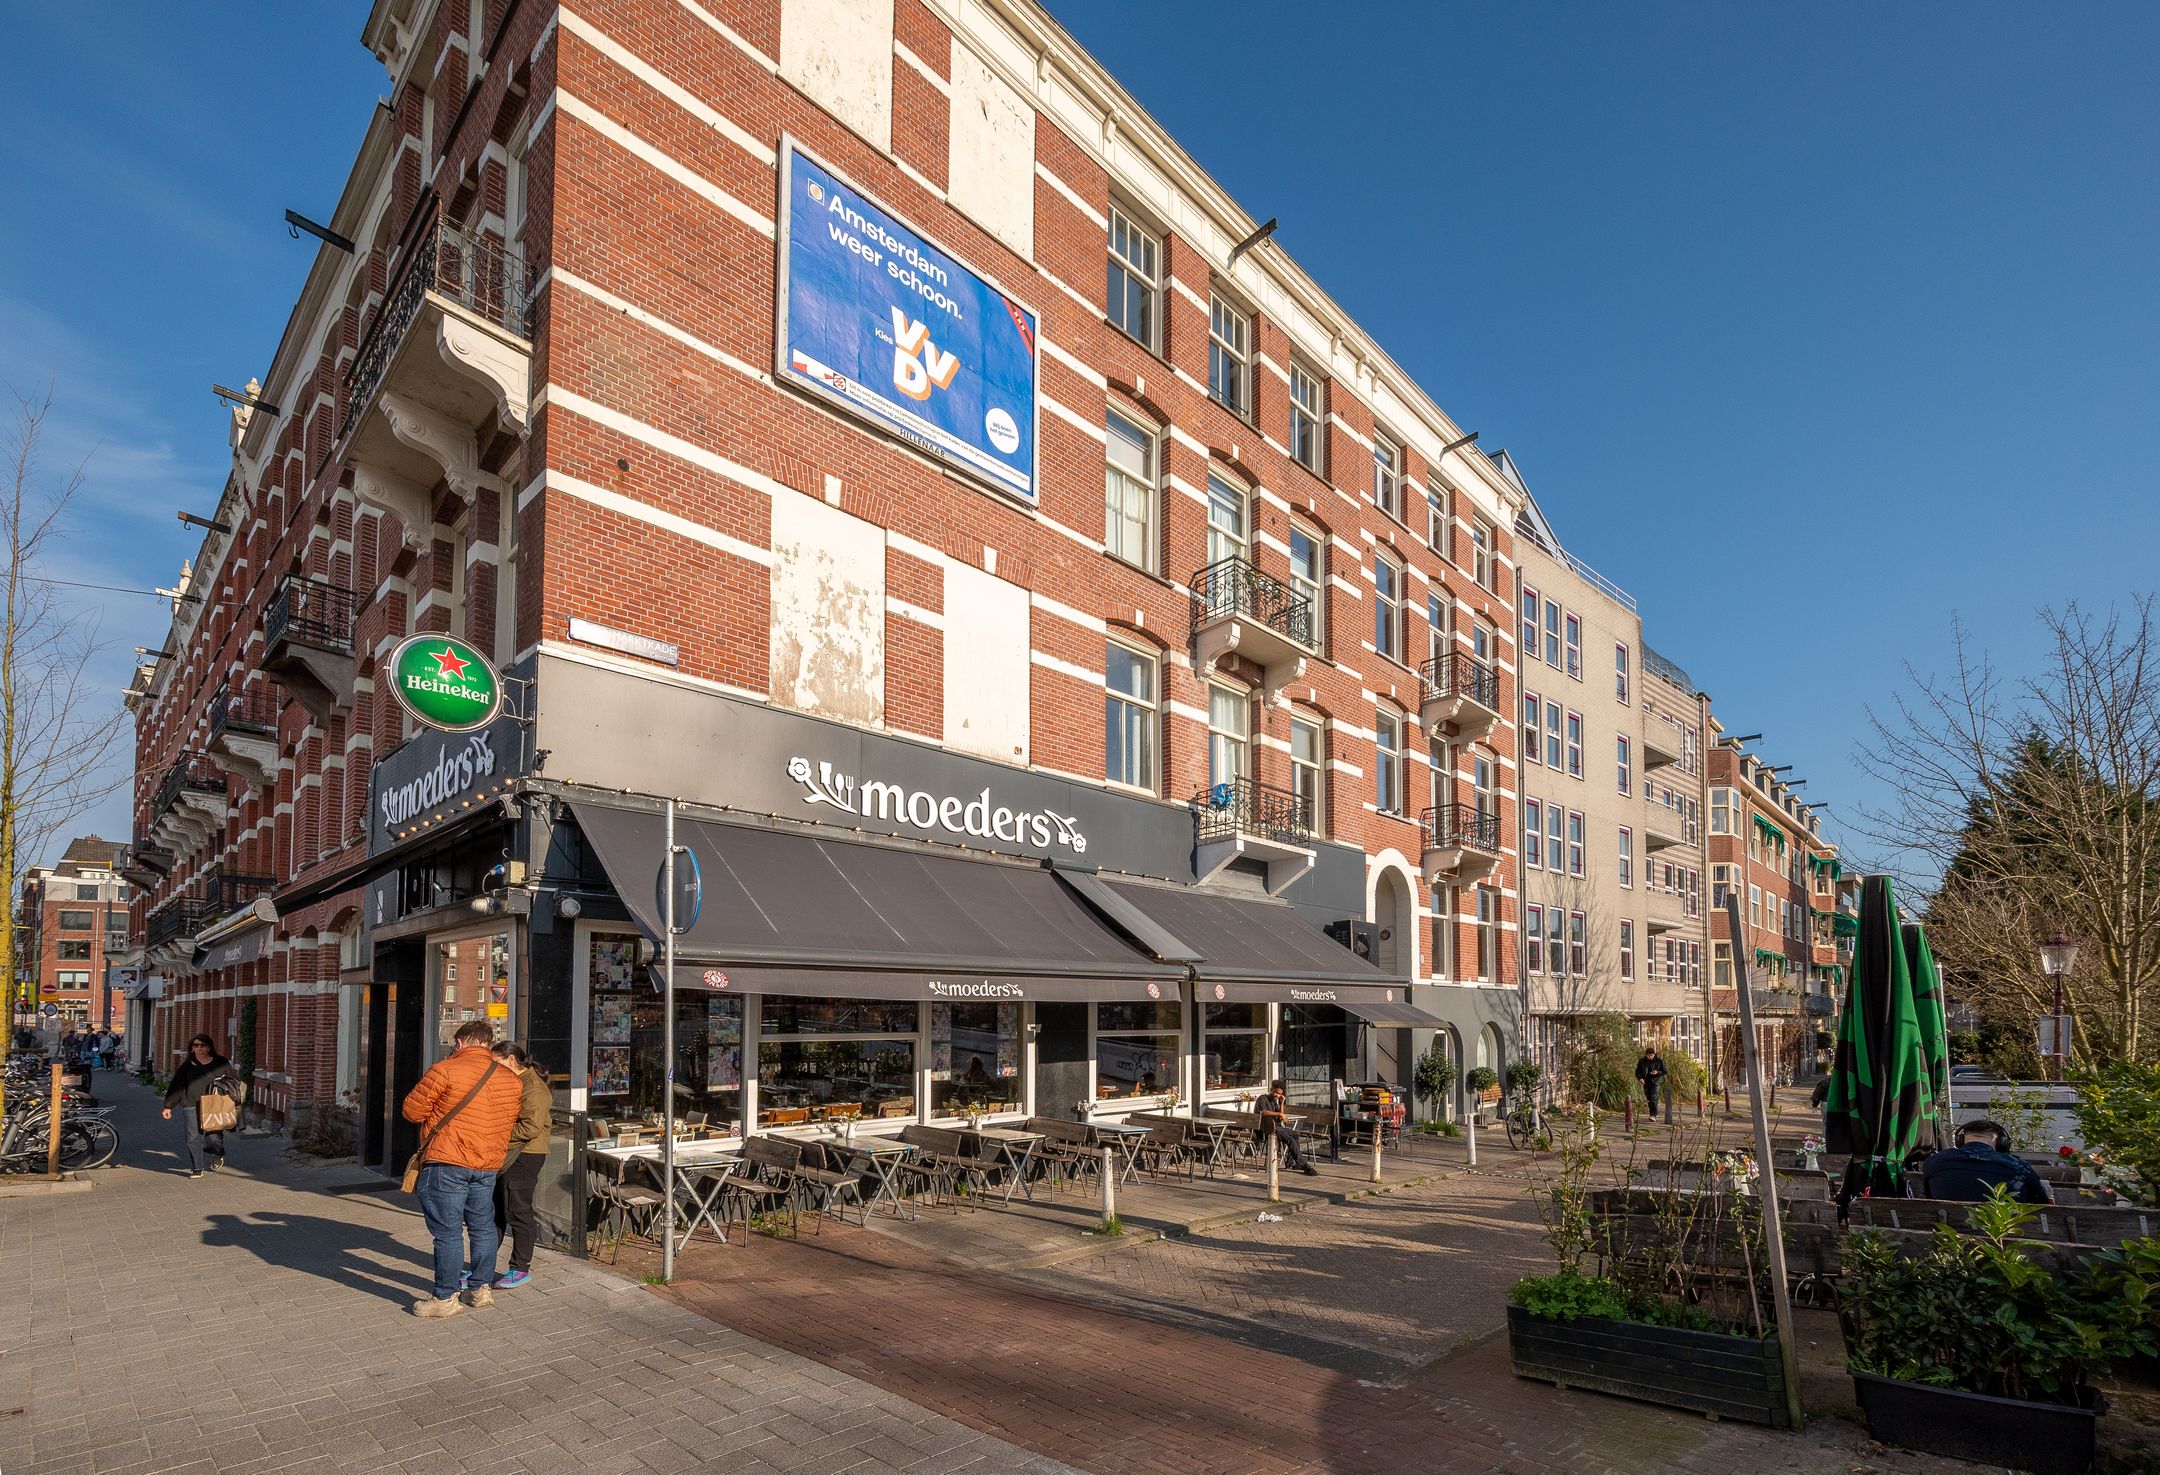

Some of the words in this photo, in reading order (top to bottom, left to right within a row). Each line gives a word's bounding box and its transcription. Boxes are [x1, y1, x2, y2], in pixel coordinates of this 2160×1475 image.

[829, 195, 947, 287] Amsterdam
[828, 222, 883, 268] weer
[887, 261, 963, 320] schoon.
[875, 327, 894, 345] Kies
[900, 429, 945, 458] HILLENAAR
[407, 675, 490, 704] Heineken
[399, 744, 473, 824] moeders
[860, 780, 1051, 848] moeders
[948, 979, 1011, 997] moeders
[1300, 988, 1329, 1000] moeders
